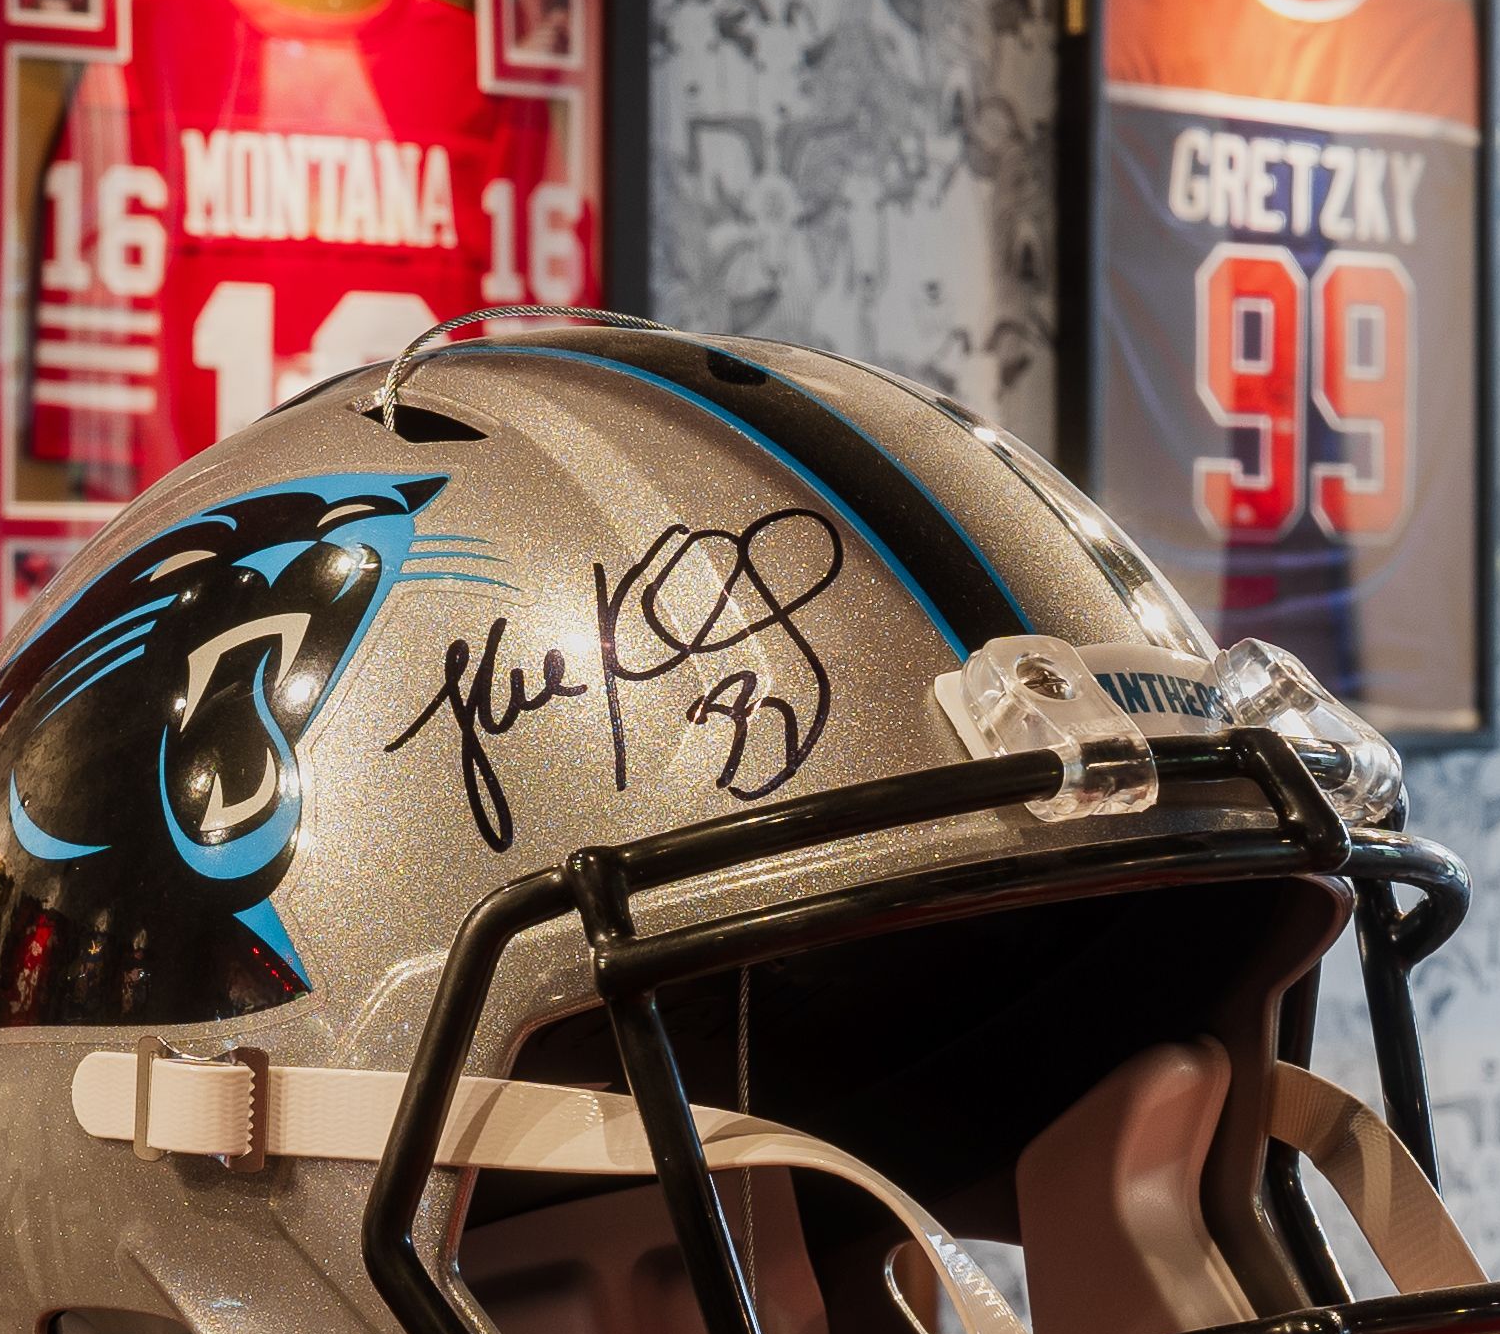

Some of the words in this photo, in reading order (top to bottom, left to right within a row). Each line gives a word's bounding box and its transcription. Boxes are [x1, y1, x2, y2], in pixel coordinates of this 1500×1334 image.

[43, 161, 169, 297] 16
[181, 129, 459, 249] MONTANA
[481, 177, 586, 308] 16
[1168, 125, 1426, 244] GRETZKY
[1194, 240, 1417, 547] 99
[1094, 672, 1235, 725] ANTHERS
